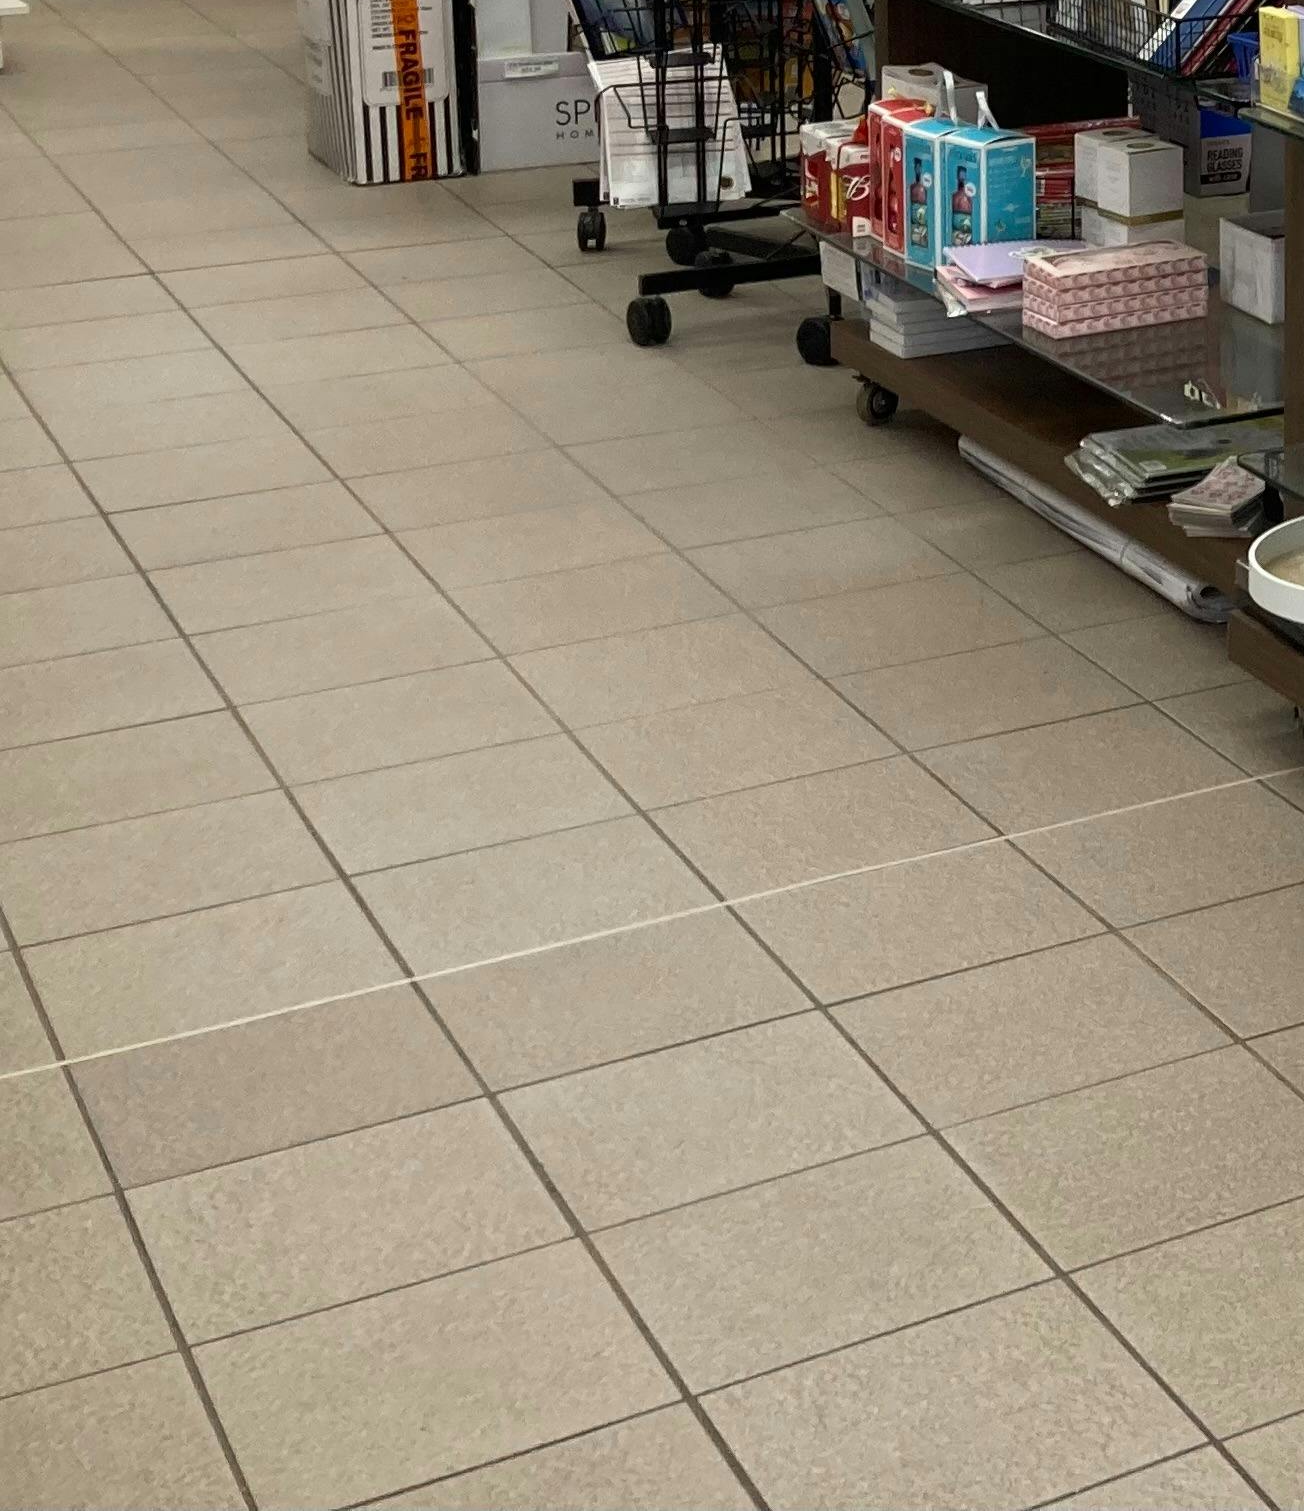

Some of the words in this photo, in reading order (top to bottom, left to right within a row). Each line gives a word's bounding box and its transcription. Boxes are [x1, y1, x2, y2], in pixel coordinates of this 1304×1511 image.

[397, 27, 425, 120] FRAGILE
[556, 99, 591, 126] SP
[556, 129, 594, 139] HOM
[1207, 148, 1244, 160] READING
[1207, 160, 1243, 172] GLASSES
